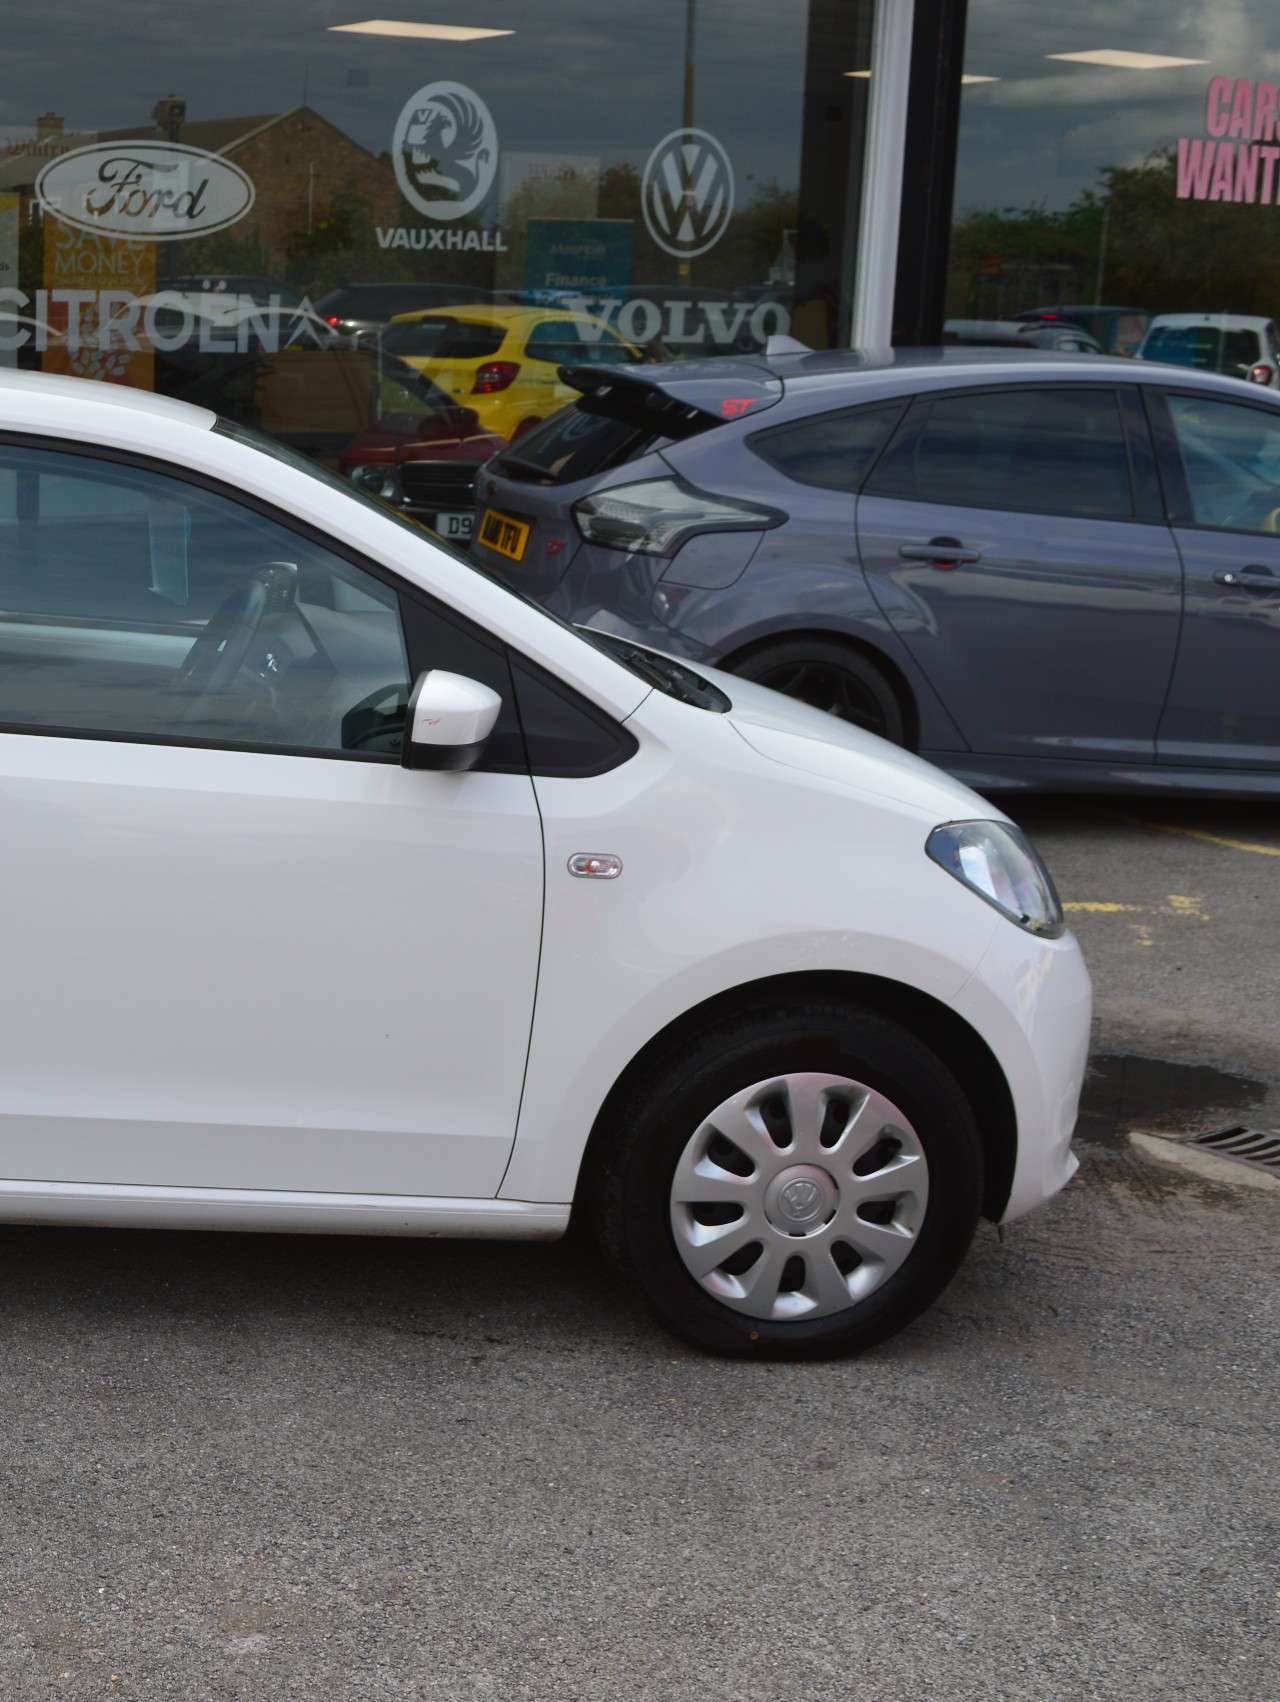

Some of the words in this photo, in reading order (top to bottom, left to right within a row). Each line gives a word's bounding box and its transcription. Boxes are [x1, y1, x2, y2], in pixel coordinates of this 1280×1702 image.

[1206, 75, 1280, 142] CAR
[86, 157, 209, 220] Ford
[1176, 138, 1280, 206] WANT
[55, 251, 144, 274] MONEY
[376, 227, 508, 252] VAUXHALL
[561, 298, 791, 344] VOLVO
